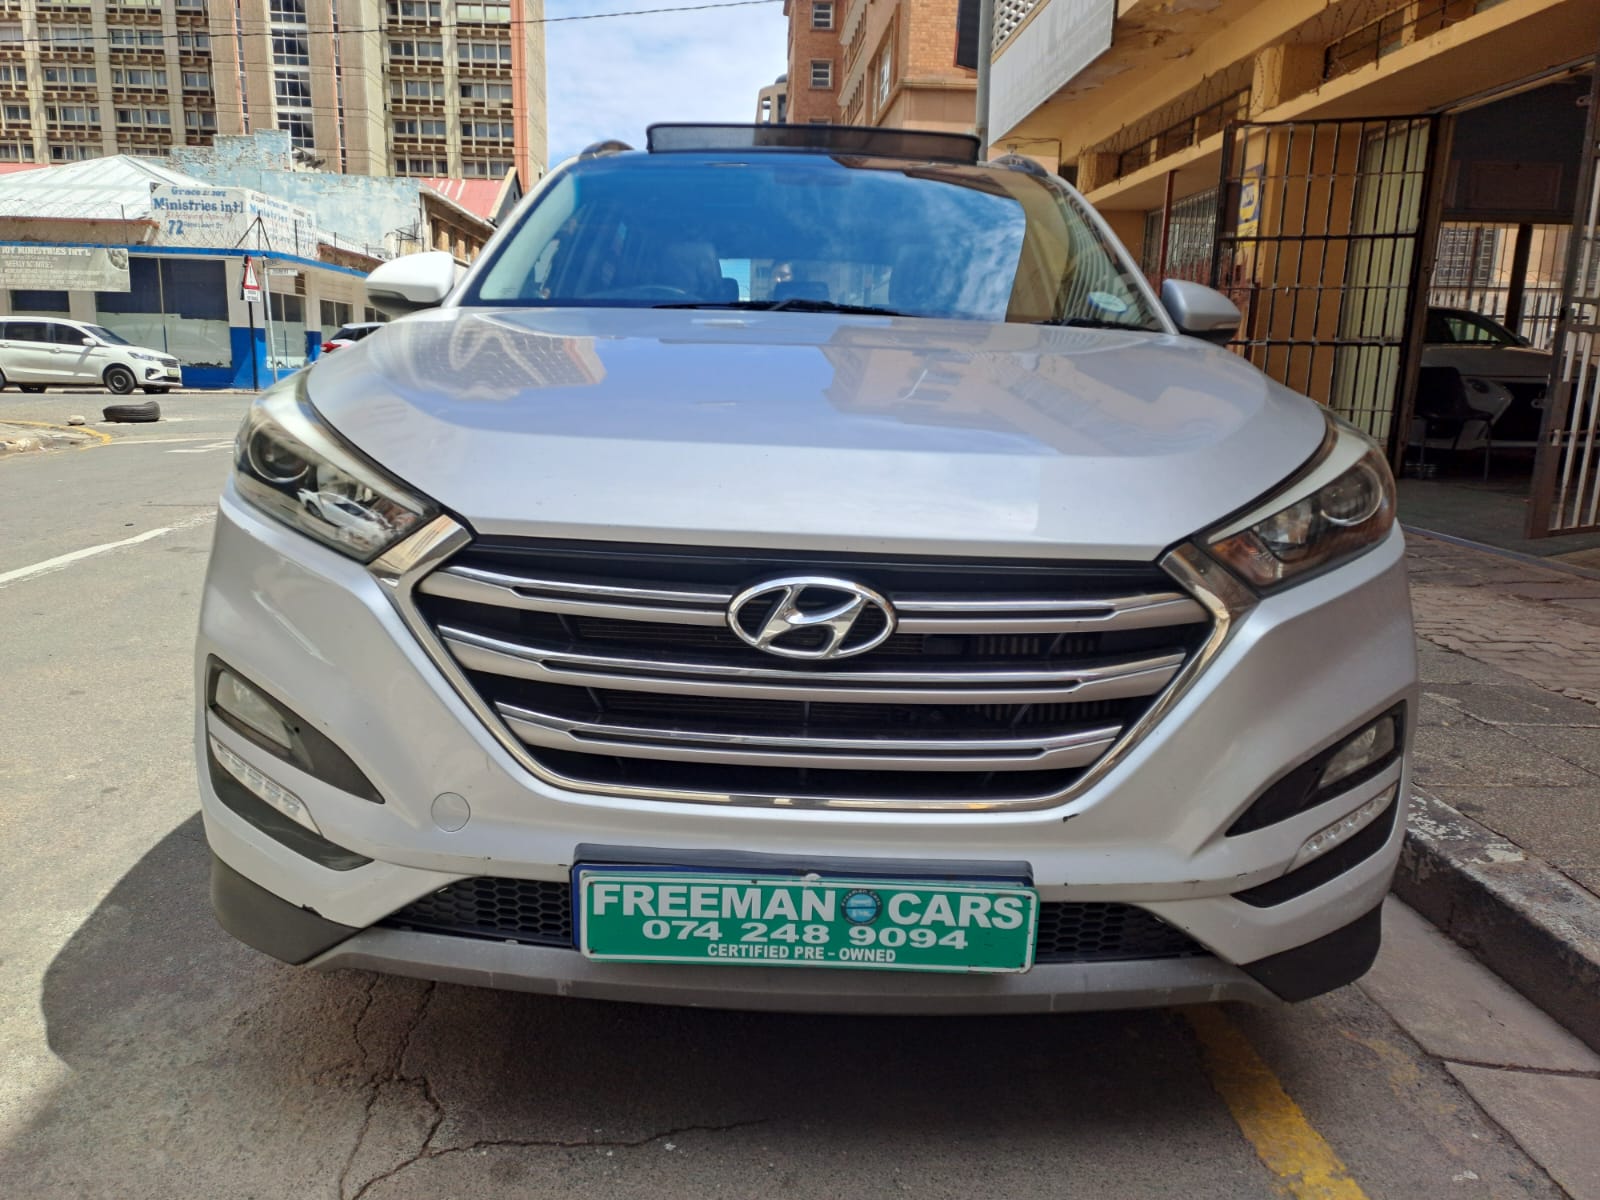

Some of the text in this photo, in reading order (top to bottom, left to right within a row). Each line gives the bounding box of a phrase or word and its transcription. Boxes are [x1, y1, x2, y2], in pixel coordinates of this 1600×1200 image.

[153, 197, 218, 211] Ministries
[168, 219, 184, 236] 72
[593, 884, 1024, 930] FREEMAN CARS
[642, 920, 968, 950] 074 248 9094
[707, 943, 789, 959] CERTIFIED
[794, 946, 824, 960] PRE
[839, 948, 896, 962] OWNED
